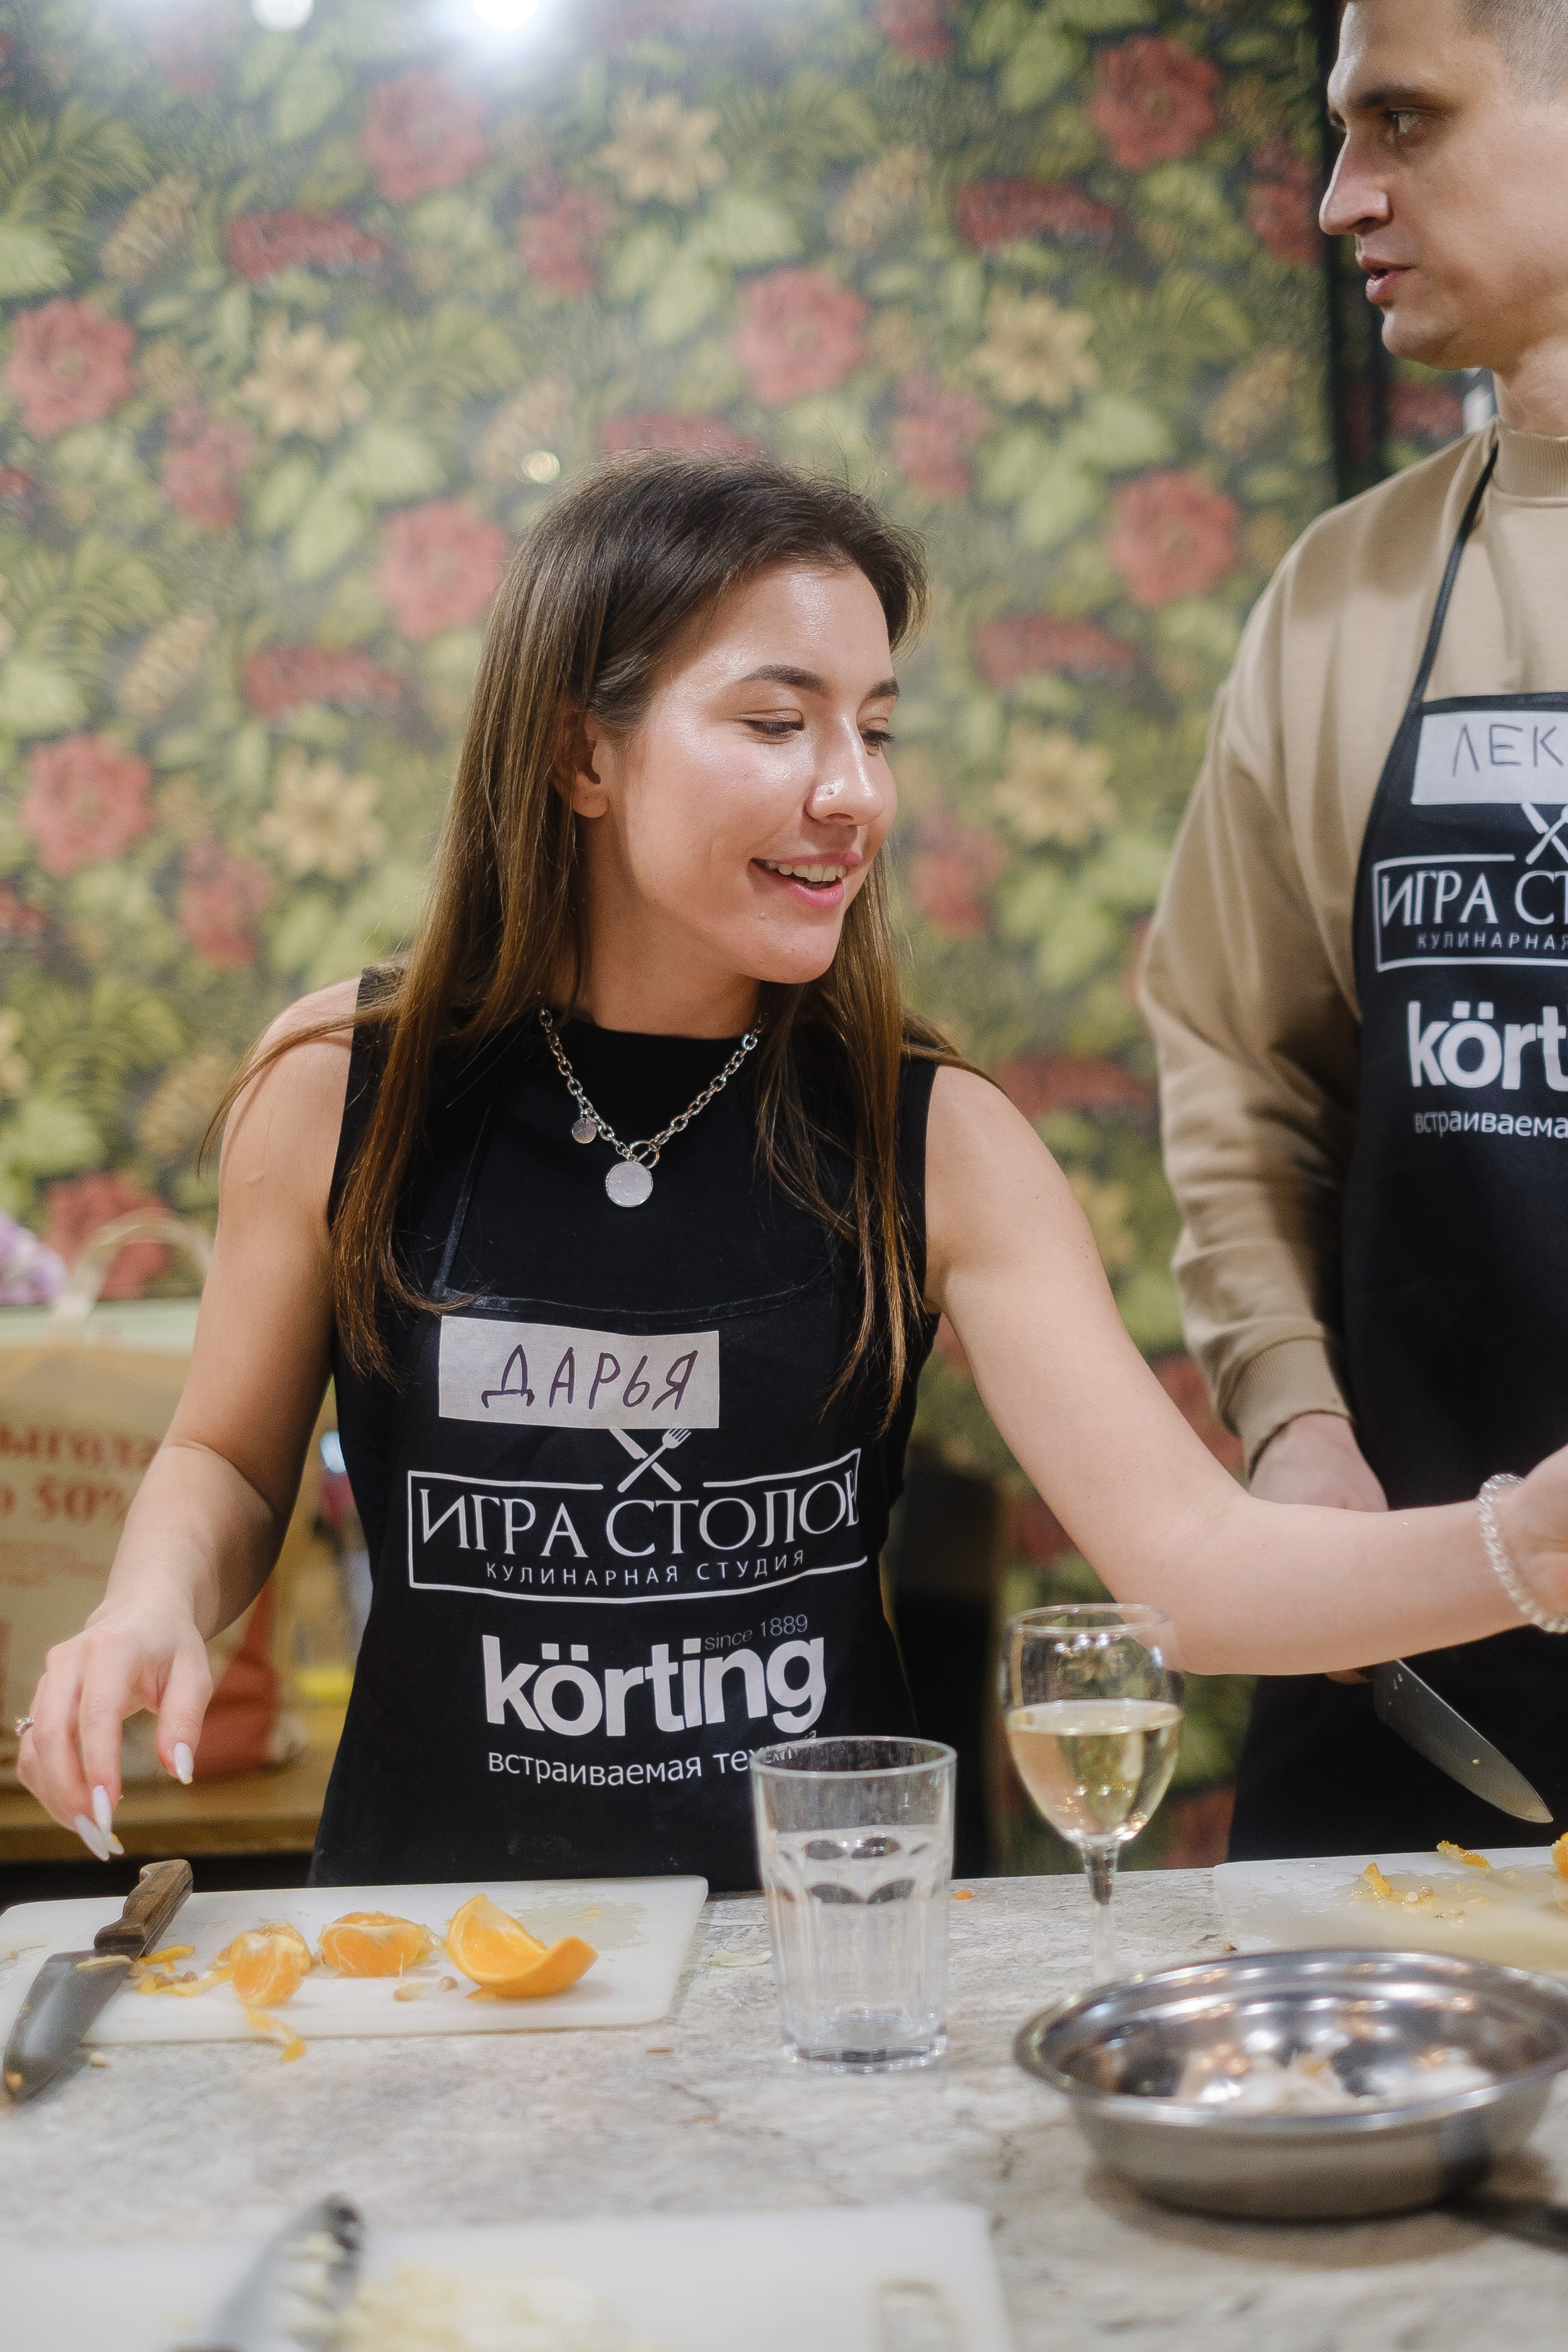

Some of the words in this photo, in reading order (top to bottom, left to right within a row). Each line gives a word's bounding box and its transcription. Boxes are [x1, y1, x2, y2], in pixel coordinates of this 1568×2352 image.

[1382, 870, 1499, 927] ИГРА
[1408, 1000, 1568, 1092] kört
[481, 1344, 699, 1411] ДАРЬЯ
[420, 1489, 589, 1558] ИГРА
[486, 1562, 678, 1586] КУЛИНАРНАЯ
[696, 1550, 803, 1580] СТУДИЯ
[704, 1629, 753, 1650] since
[761, 1614, 808, 1637] 1889
[482, 1634, 826, 1737] körting
[489, 1752, 702, 1786] встраиваемая
